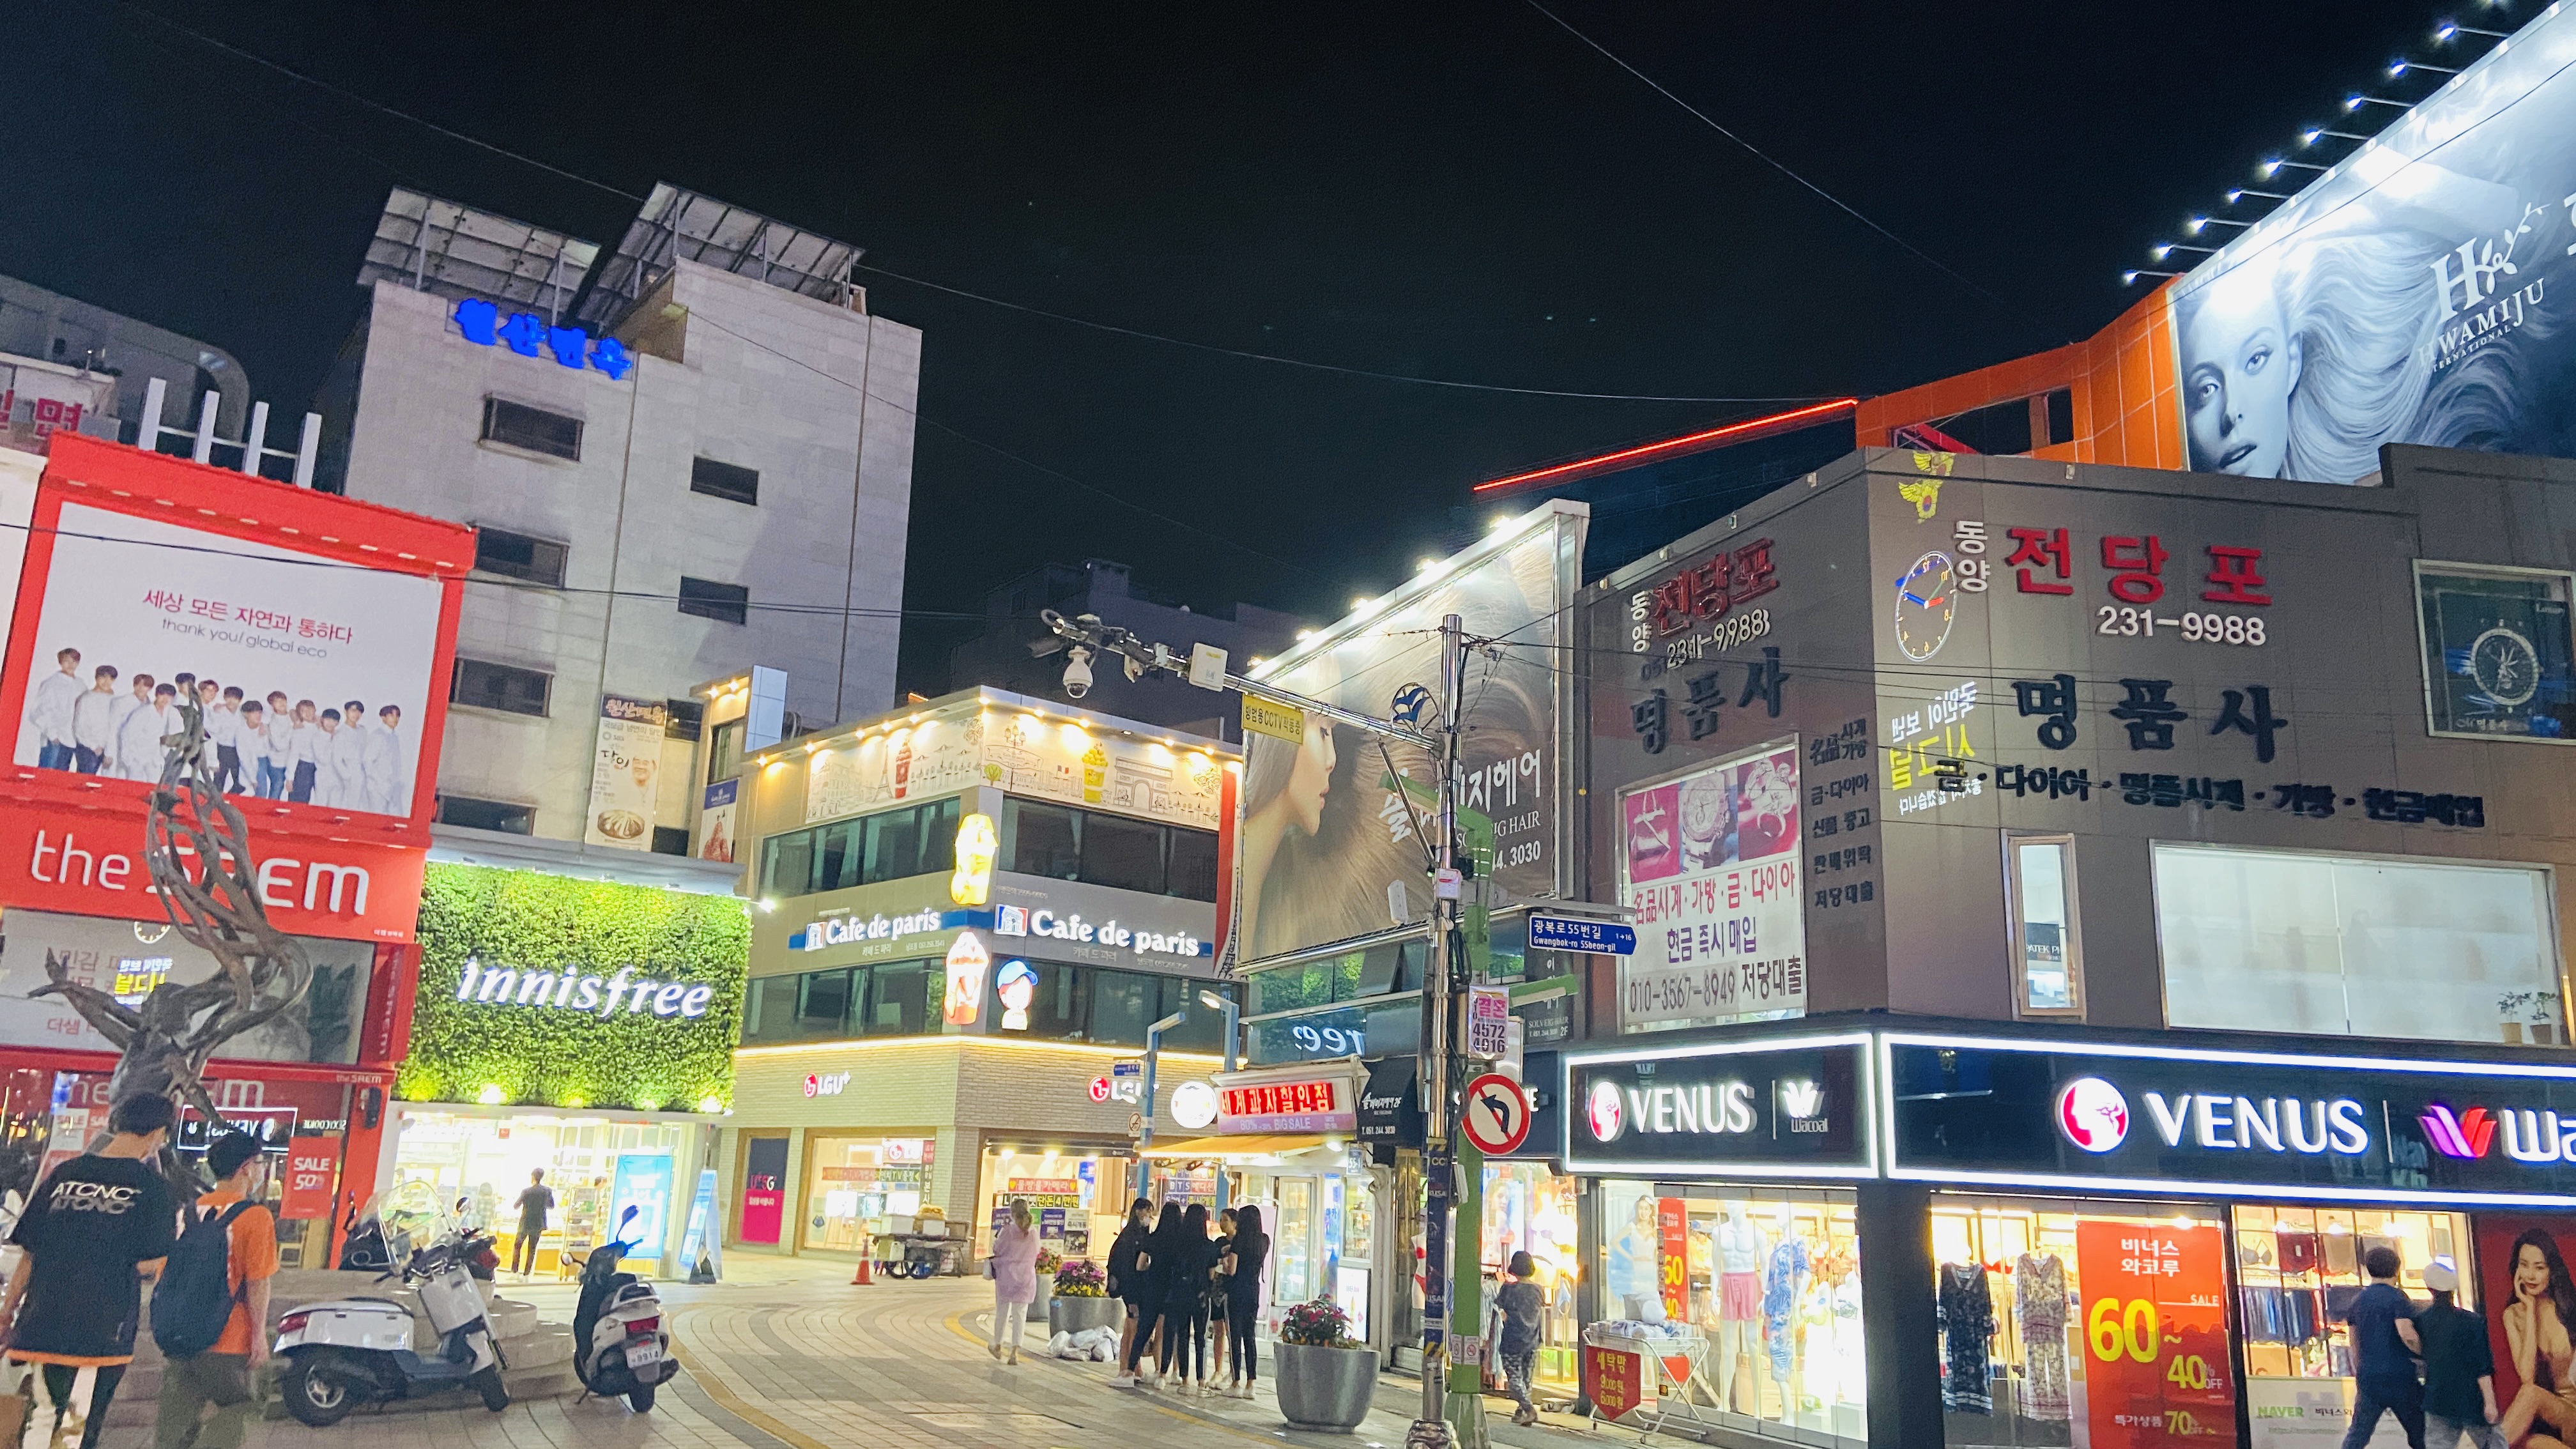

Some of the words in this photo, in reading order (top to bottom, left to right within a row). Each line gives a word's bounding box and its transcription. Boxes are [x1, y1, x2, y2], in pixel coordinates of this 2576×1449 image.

[1954, 520, 1988, 592] 동양
[2005, 526, 2272, 605] 전당포
[1652, 537, 1779, 638] 전당포
[143, 588, 183, 613] 세상
[188, 598, 228, 622] 모든
[235, 607, 292, 633] 자연과
[298, 618, 353, 645] 통하다
[2096, 605, 2267, 646] 231-9988
[162, 618, 205, 638] thank
[245, 634, 293, 654] global
[297, 645, 327, 659] eco
[1666, 608, 1770, 670] 231-9988
[1630, 646, 1790, 754] 명품사
[2012, 673, 2288, 763] 명품사
[1509, 810, 1540, 834] HAIR
[31, 830, 131, 890] the
[1510, 840, 1541, 868] 3030
[1728, 873, 1740, 909] 금
[1751, 861, 1795, 903] 다이아
[826, 916, 866, 944] Cafe
[867, 913, 890, 939] de
[891, 907, 941, 941] paris
[1031, 909, 1093, 942] Cafe
[1098, 920, 1130, 947] de
[1133, 931, 1200, 956] paris
[1534, 936, 1577, 948] Gwangbok-ro
[1667, 926, 1692, 963] 현금
[1699, 919, 1724, 958] 즉시
[1729, 916, 1756, 954] 매입
[457, 956, 713, 1019] innisfree
[1630, 970, 1736, 1013] 010-3567-8949
[1742, 954, 1802, 999] 저당대출
[1473, 1023, 1505, 1039] 4572
[1560, 1025, 1568, 1037] 2F
[1221, 1083, 1330, 1116] 세계과자할인점
[1629, 1081, 1752, 1133] VENUS
[1791, 1117, 1828, 1133] Wacoal
[2143, 1092, 2368, 1154] VENUS
[294, 1157, 330, 1171] SALE
[2120, 1238, 2181, 1258] 비너스
[2120, 1258, 2181, 1277] 와코루
[2190, 1294, 2219, 1307] SALE
[2089, 1298, 2159, 1363] 60
[2205, 1378, 2223, 1390] OFF
[2115, 1414, 2163, 1428] 특가상품
[2257, 1406, 2304, 1418] NAVER
